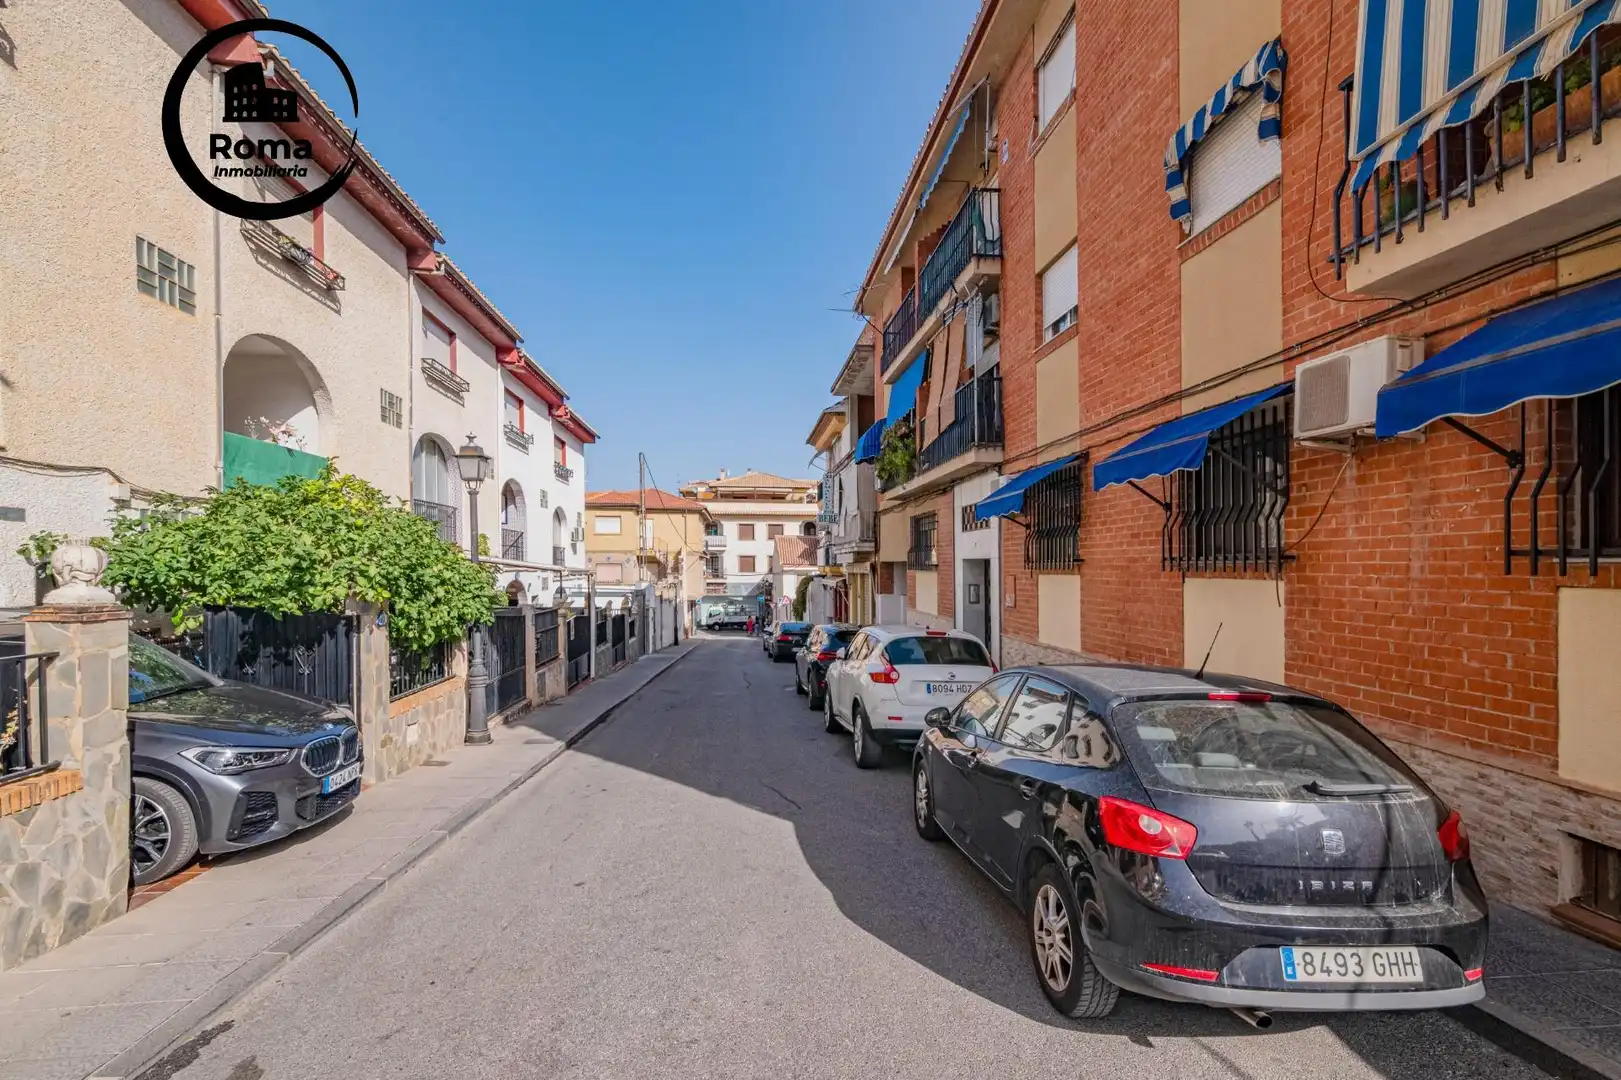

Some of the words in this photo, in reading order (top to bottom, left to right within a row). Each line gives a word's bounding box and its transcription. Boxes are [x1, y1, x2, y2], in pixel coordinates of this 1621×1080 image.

[932, 684, 954, 693] 8094
[1301, 951, 1364, 977] 8493
[1371, 951, 1417, 977] GHH
